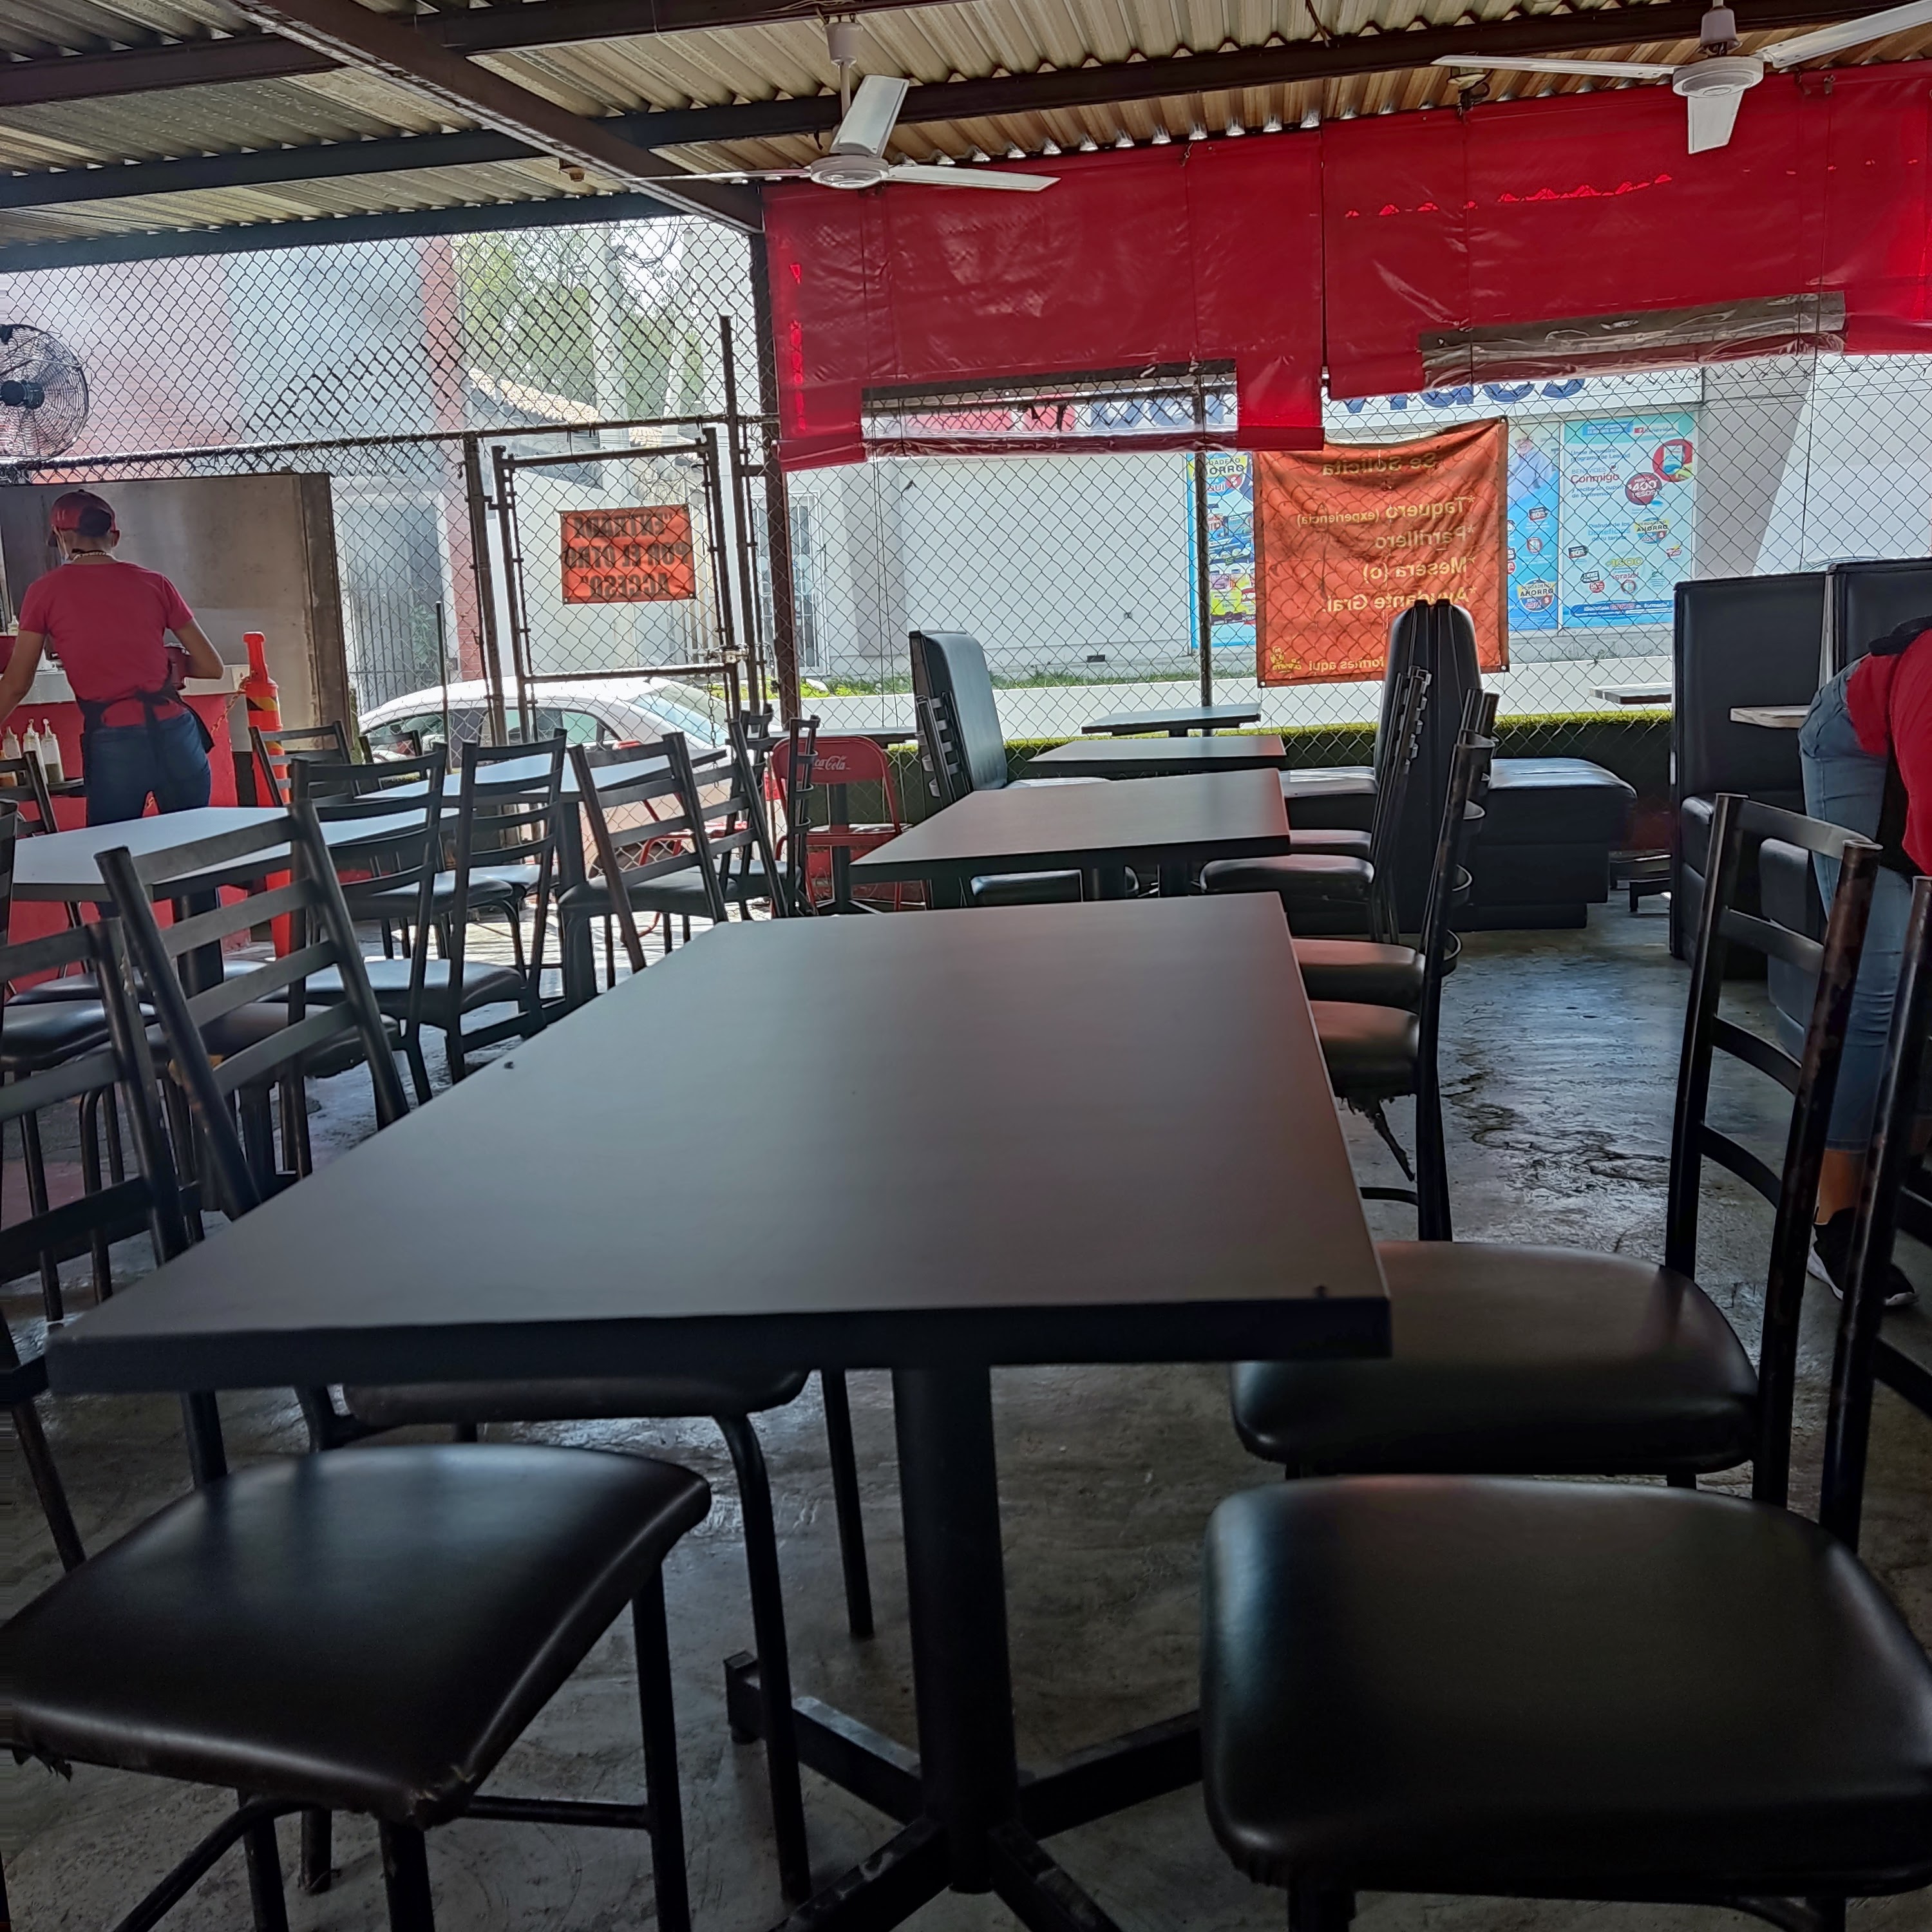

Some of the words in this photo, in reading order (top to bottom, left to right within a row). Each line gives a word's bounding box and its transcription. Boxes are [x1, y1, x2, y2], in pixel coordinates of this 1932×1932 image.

[1206, 457, 1240, 466] DADERO
[1206, 464, 1244, 475] ORRO
[1570, 473, 1620, 484] Conmigo
[1520, 588, 1554, 597] AHORRO
[813, 755, 849, 771] ca-Cola
